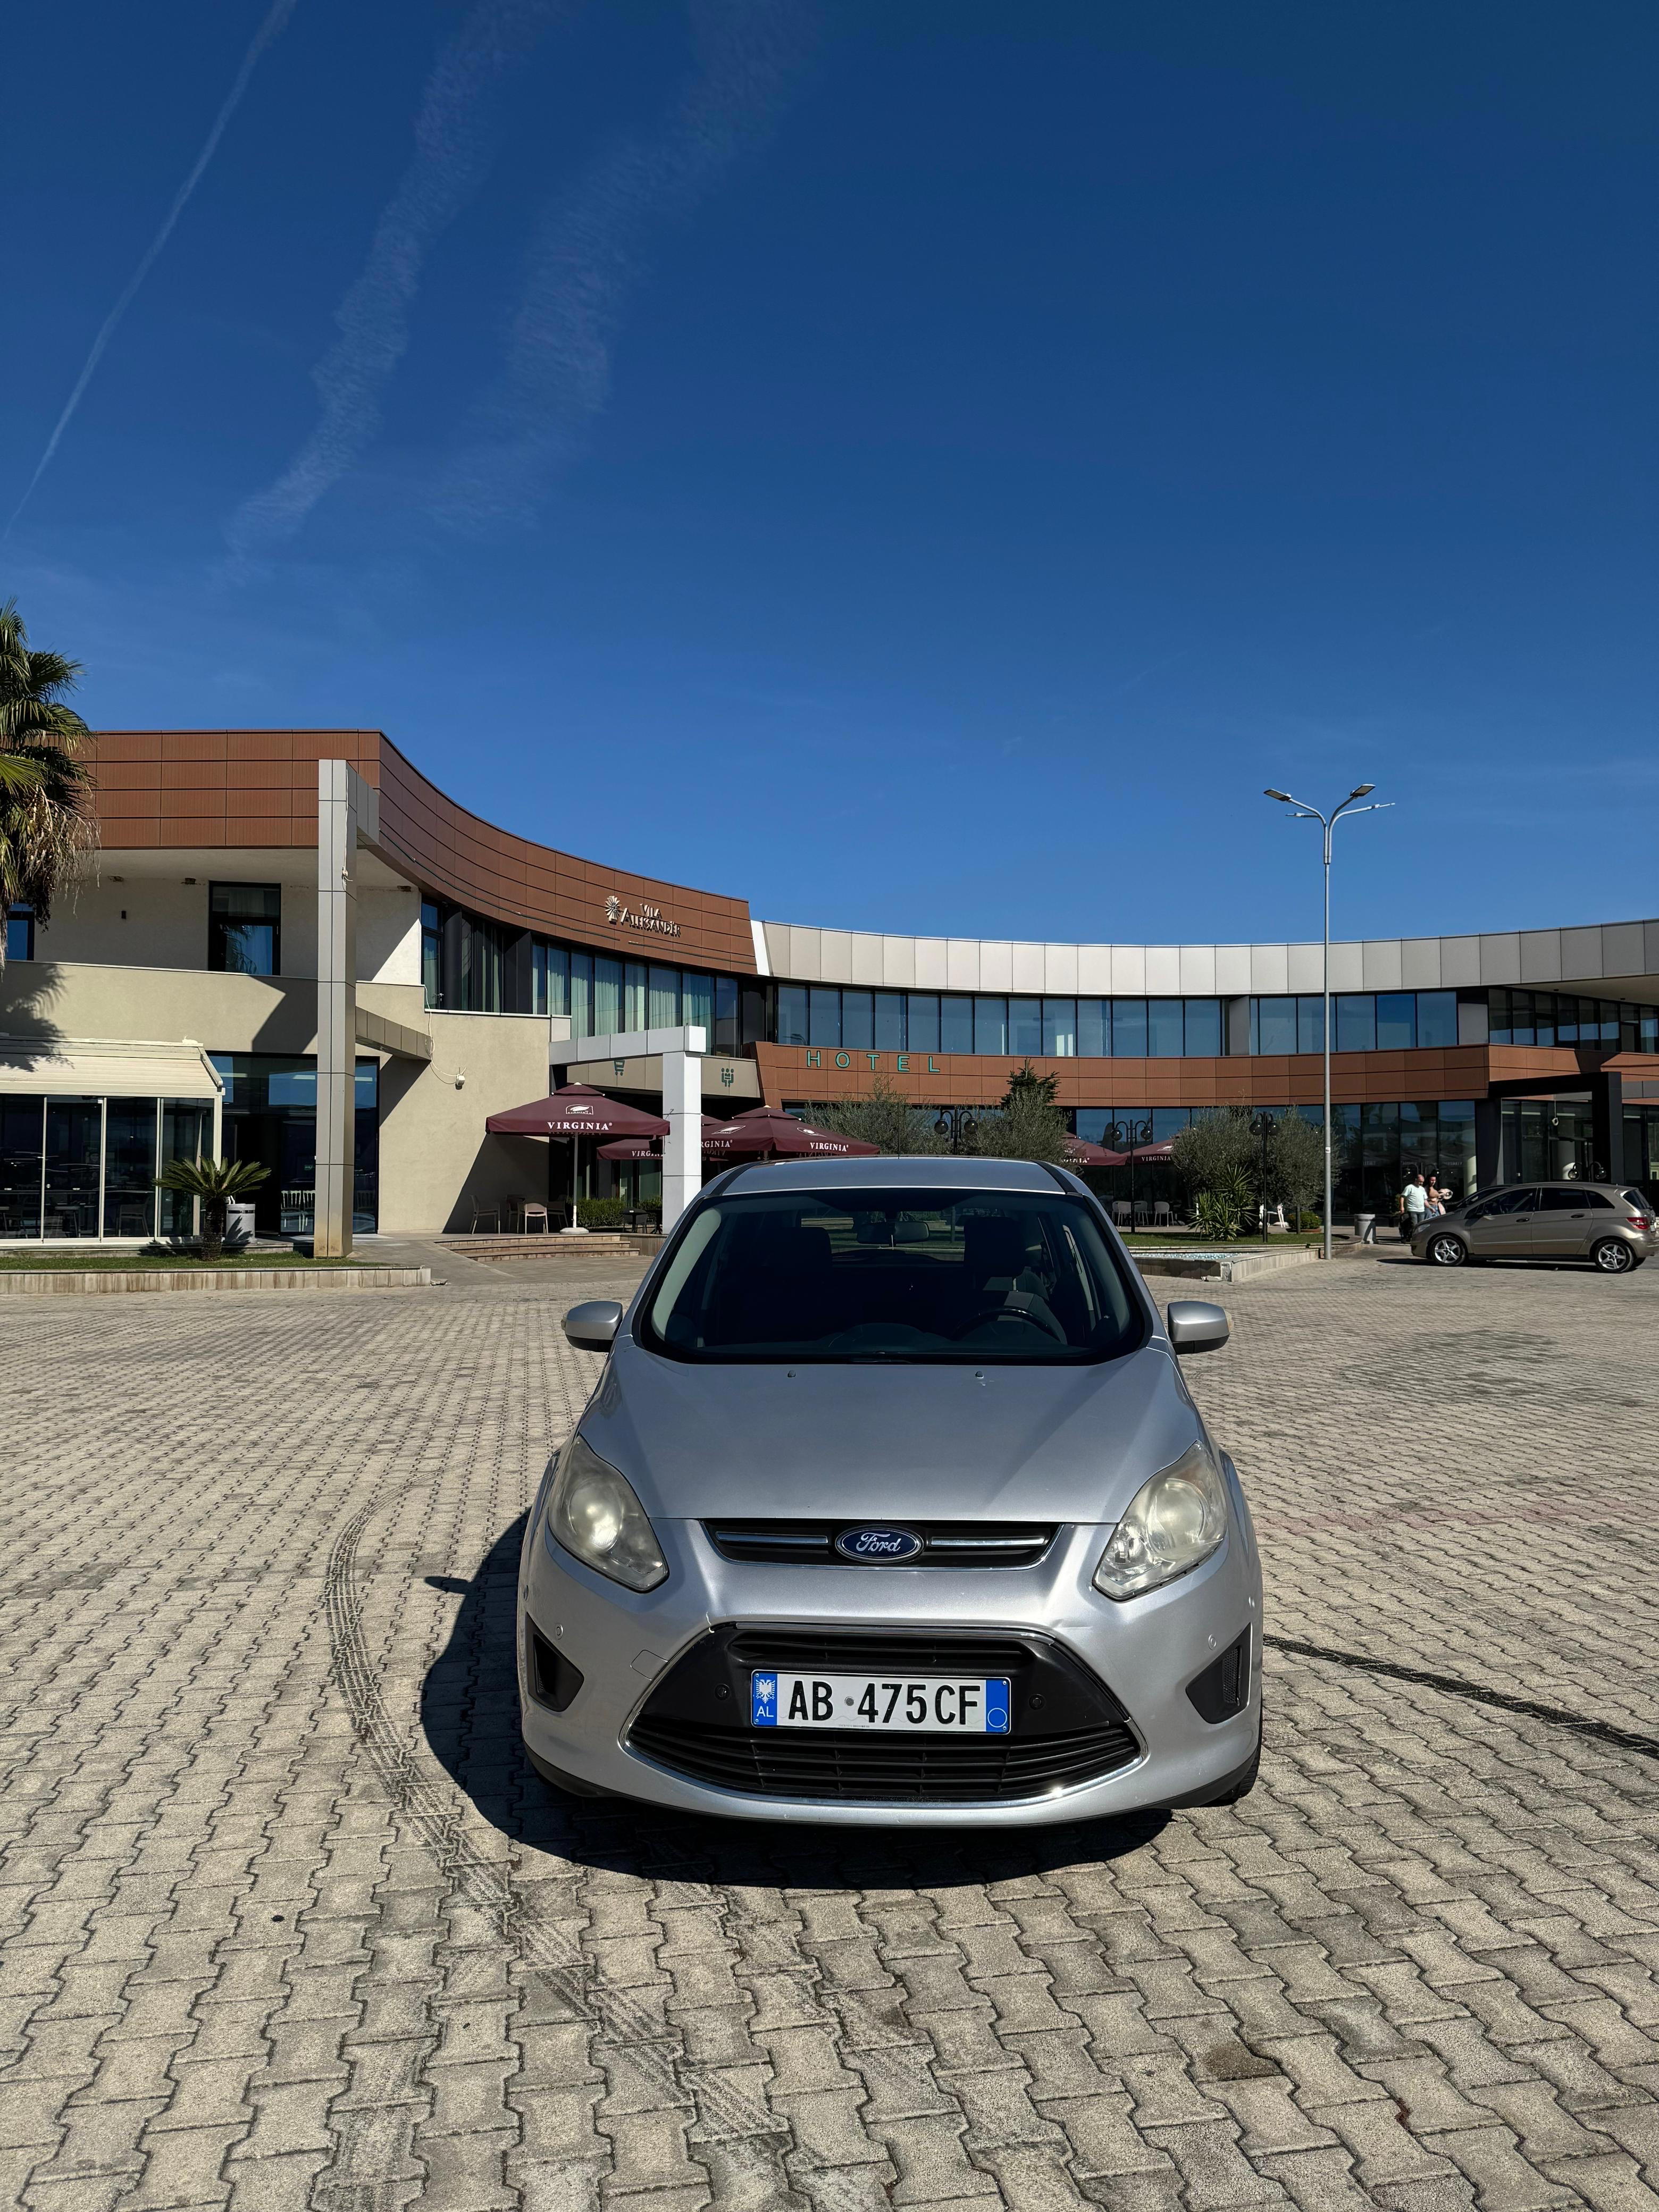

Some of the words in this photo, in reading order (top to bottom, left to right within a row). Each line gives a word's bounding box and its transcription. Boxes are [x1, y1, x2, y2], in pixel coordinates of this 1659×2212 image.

[640, 903, 663, 919] VILA
[807, 1050, 941, 1073] HOTEL
[856, 1532, 901, 1552] Ford
[788, 1681, 833, 1721] AB
[756, 1706, 774, 1717] AL
